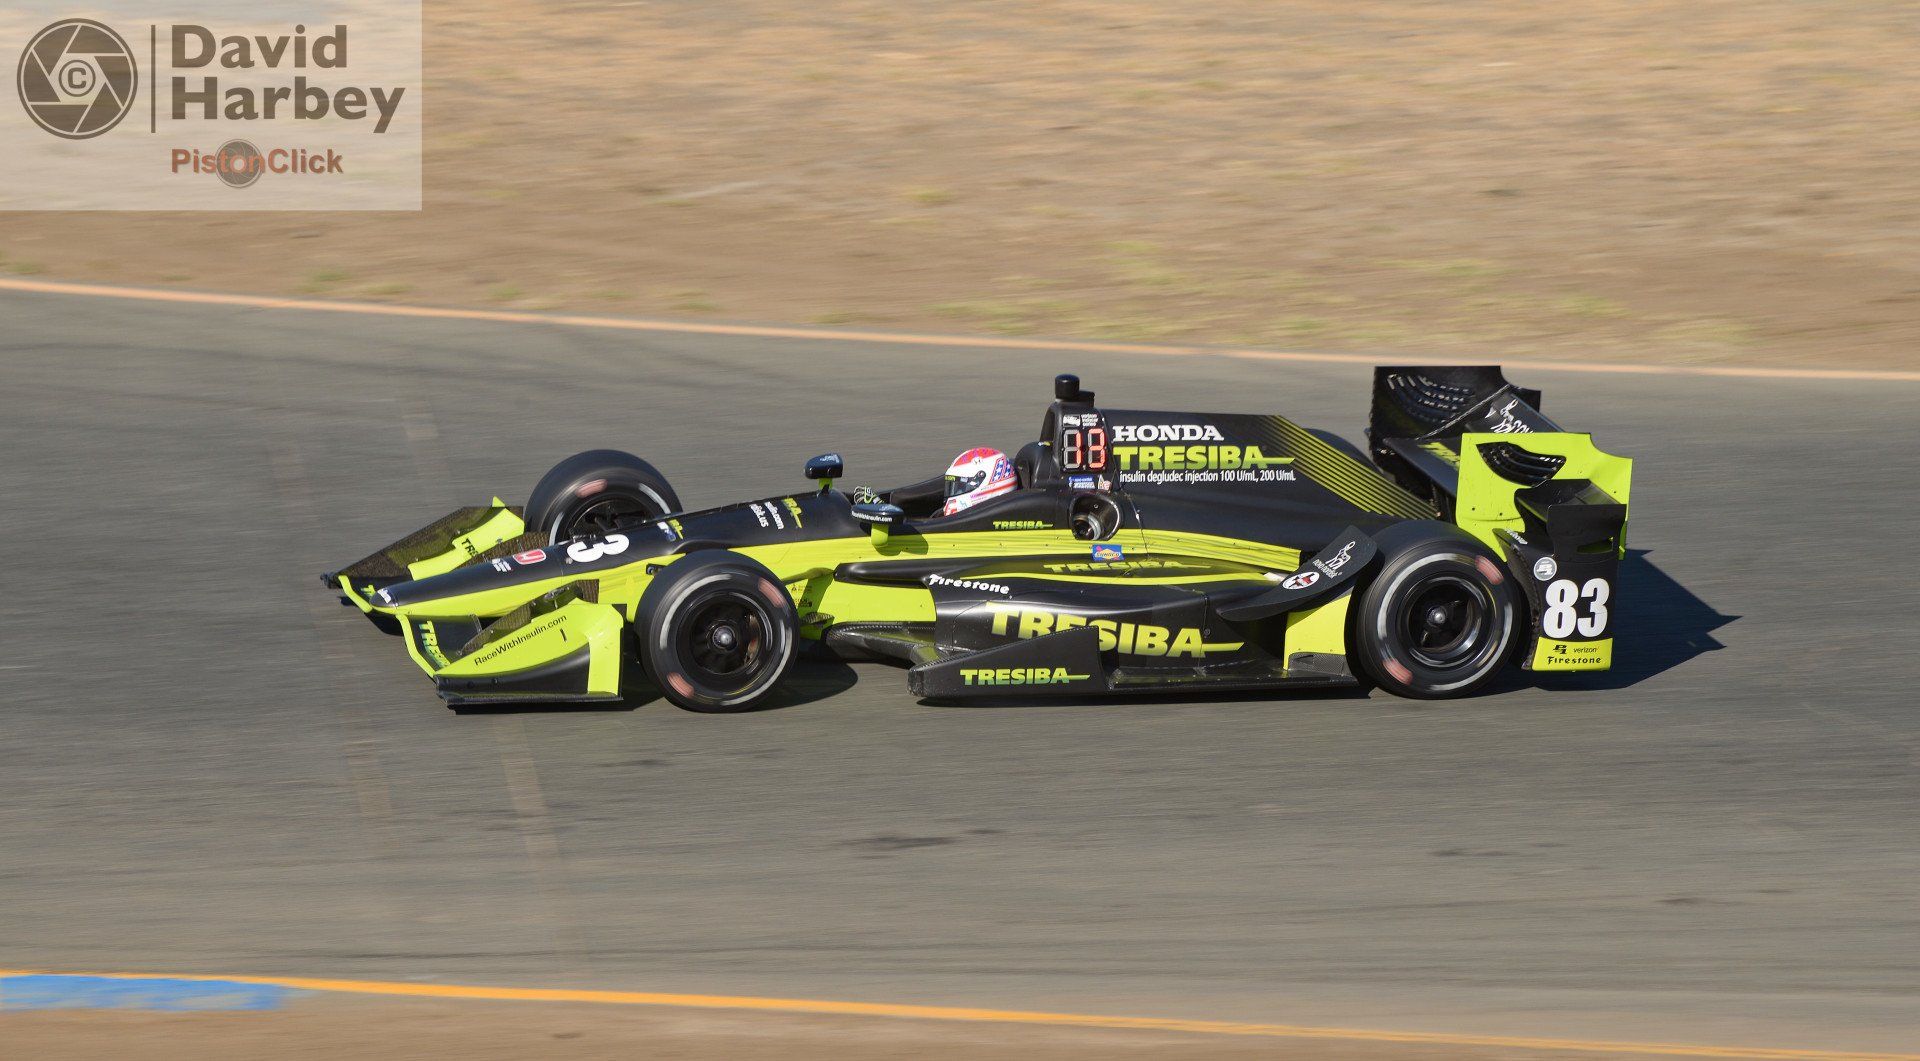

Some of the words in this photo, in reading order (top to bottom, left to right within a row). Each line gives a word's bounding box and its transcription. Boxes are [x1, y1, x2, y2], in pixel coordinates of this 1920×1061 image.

[1112, 424, 1224, 441] HONDA
[1113, 445, 1295, 470] TRESIBA
[1119, 471, 1145, 482] insulin
[1147, 470, 1183, 485] degludec
[1185, 470, 1218, 484] injection
[1220, 470, 1235, 482] 100
[1260, 470, 1275, 482] 200
[993, 520, 1053, 530] TRESIBA
[1043, 559, 1211, 574] TRESIBA
[929, 573, 1009, 595] Firestone
[1543, 578, 1609, 638] 83
[474, 614, 567, 666] RaceWithInsulin.com
[1547, 656, 1602, 665] Firestone
[960, 667, 1091, 686] TRESIBA
